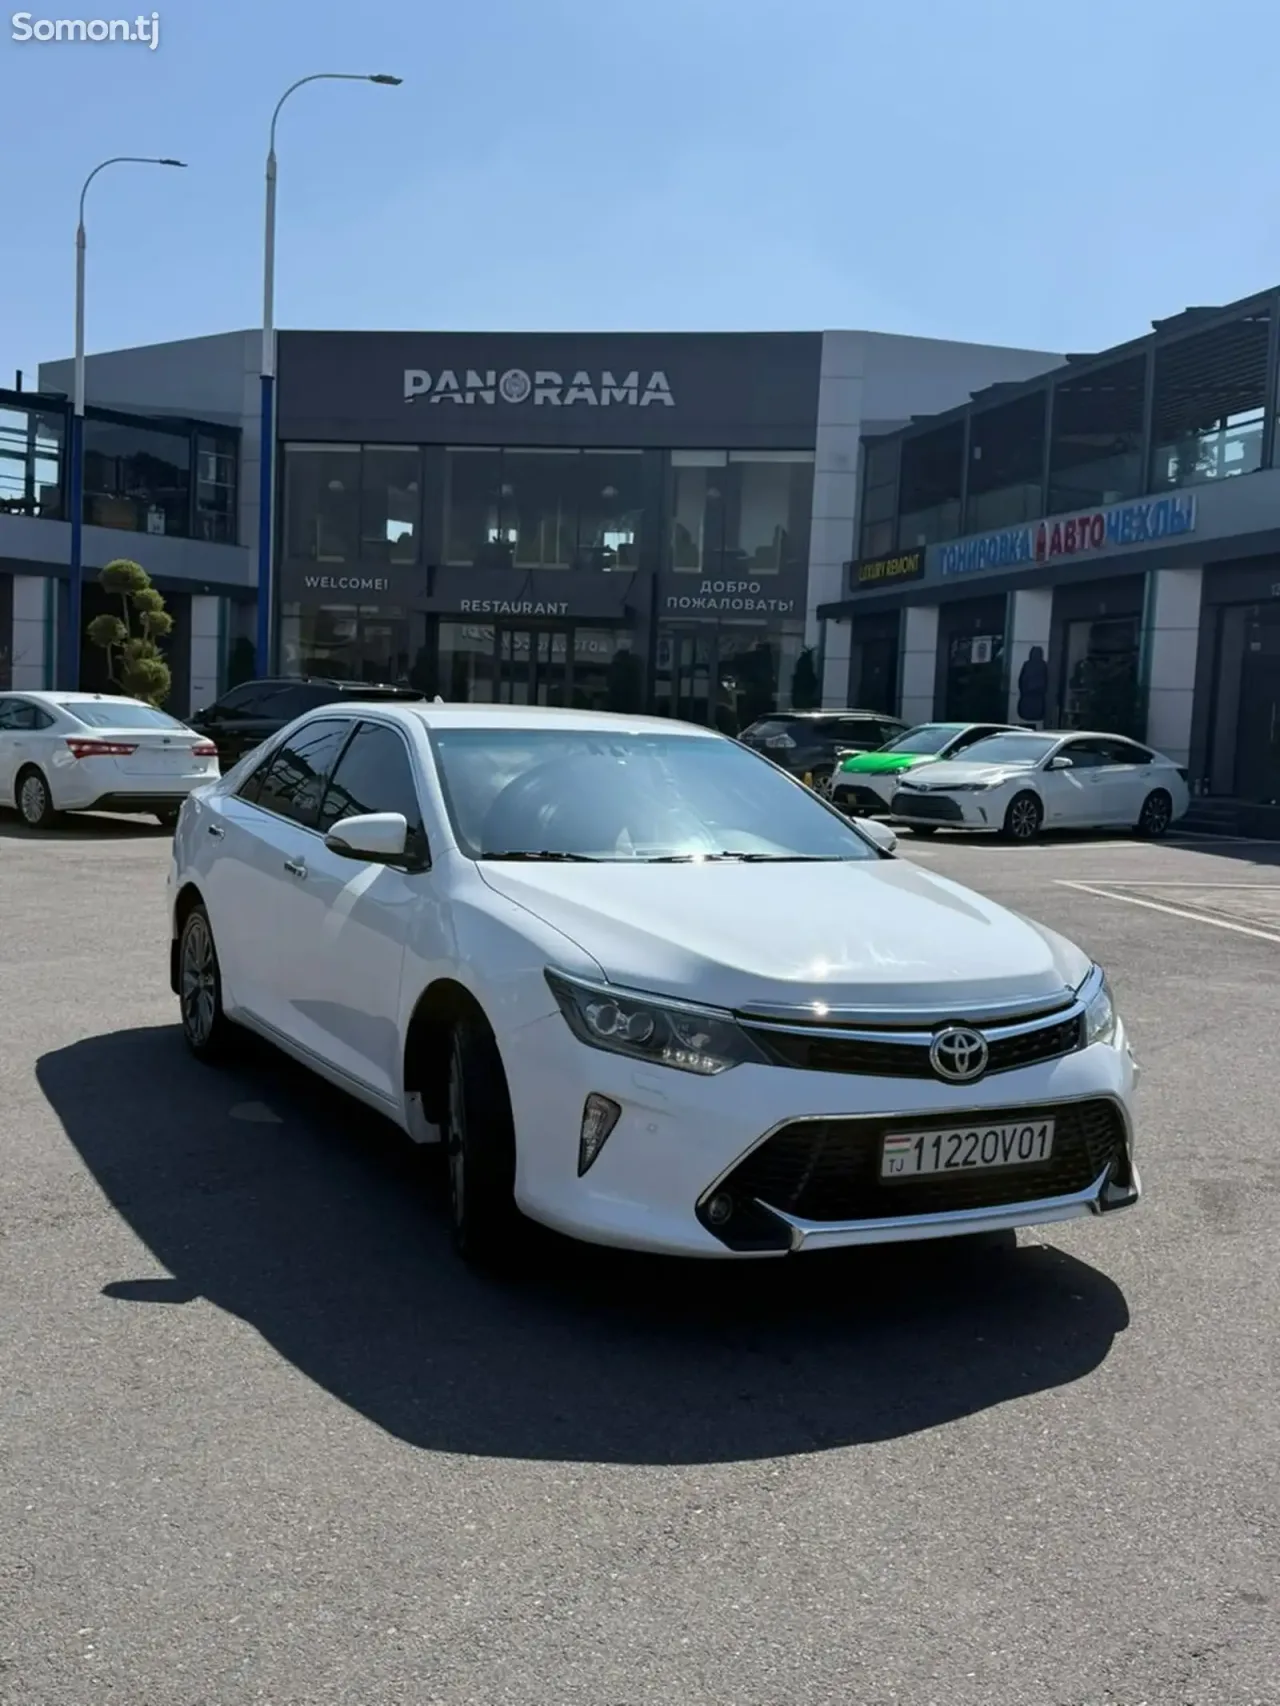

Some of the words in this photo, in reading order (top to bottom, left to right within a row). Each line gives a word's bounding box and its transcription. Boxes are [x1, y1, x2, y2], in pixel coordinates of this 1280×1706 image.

[403, 368, 676, 406] PANORAMA
[938, 528, 1033, 575] ТОНИРОВКА
[305, 575, 388, 590] WELCOME!
[700, 580, 761, 594] ДОБРО
[460, 599, 569, 615] RESTAURANT
[667, 596, 794, 611] ПОЖАЛОВАТЬ!
[888, 1158, 905, 1173] TJ
